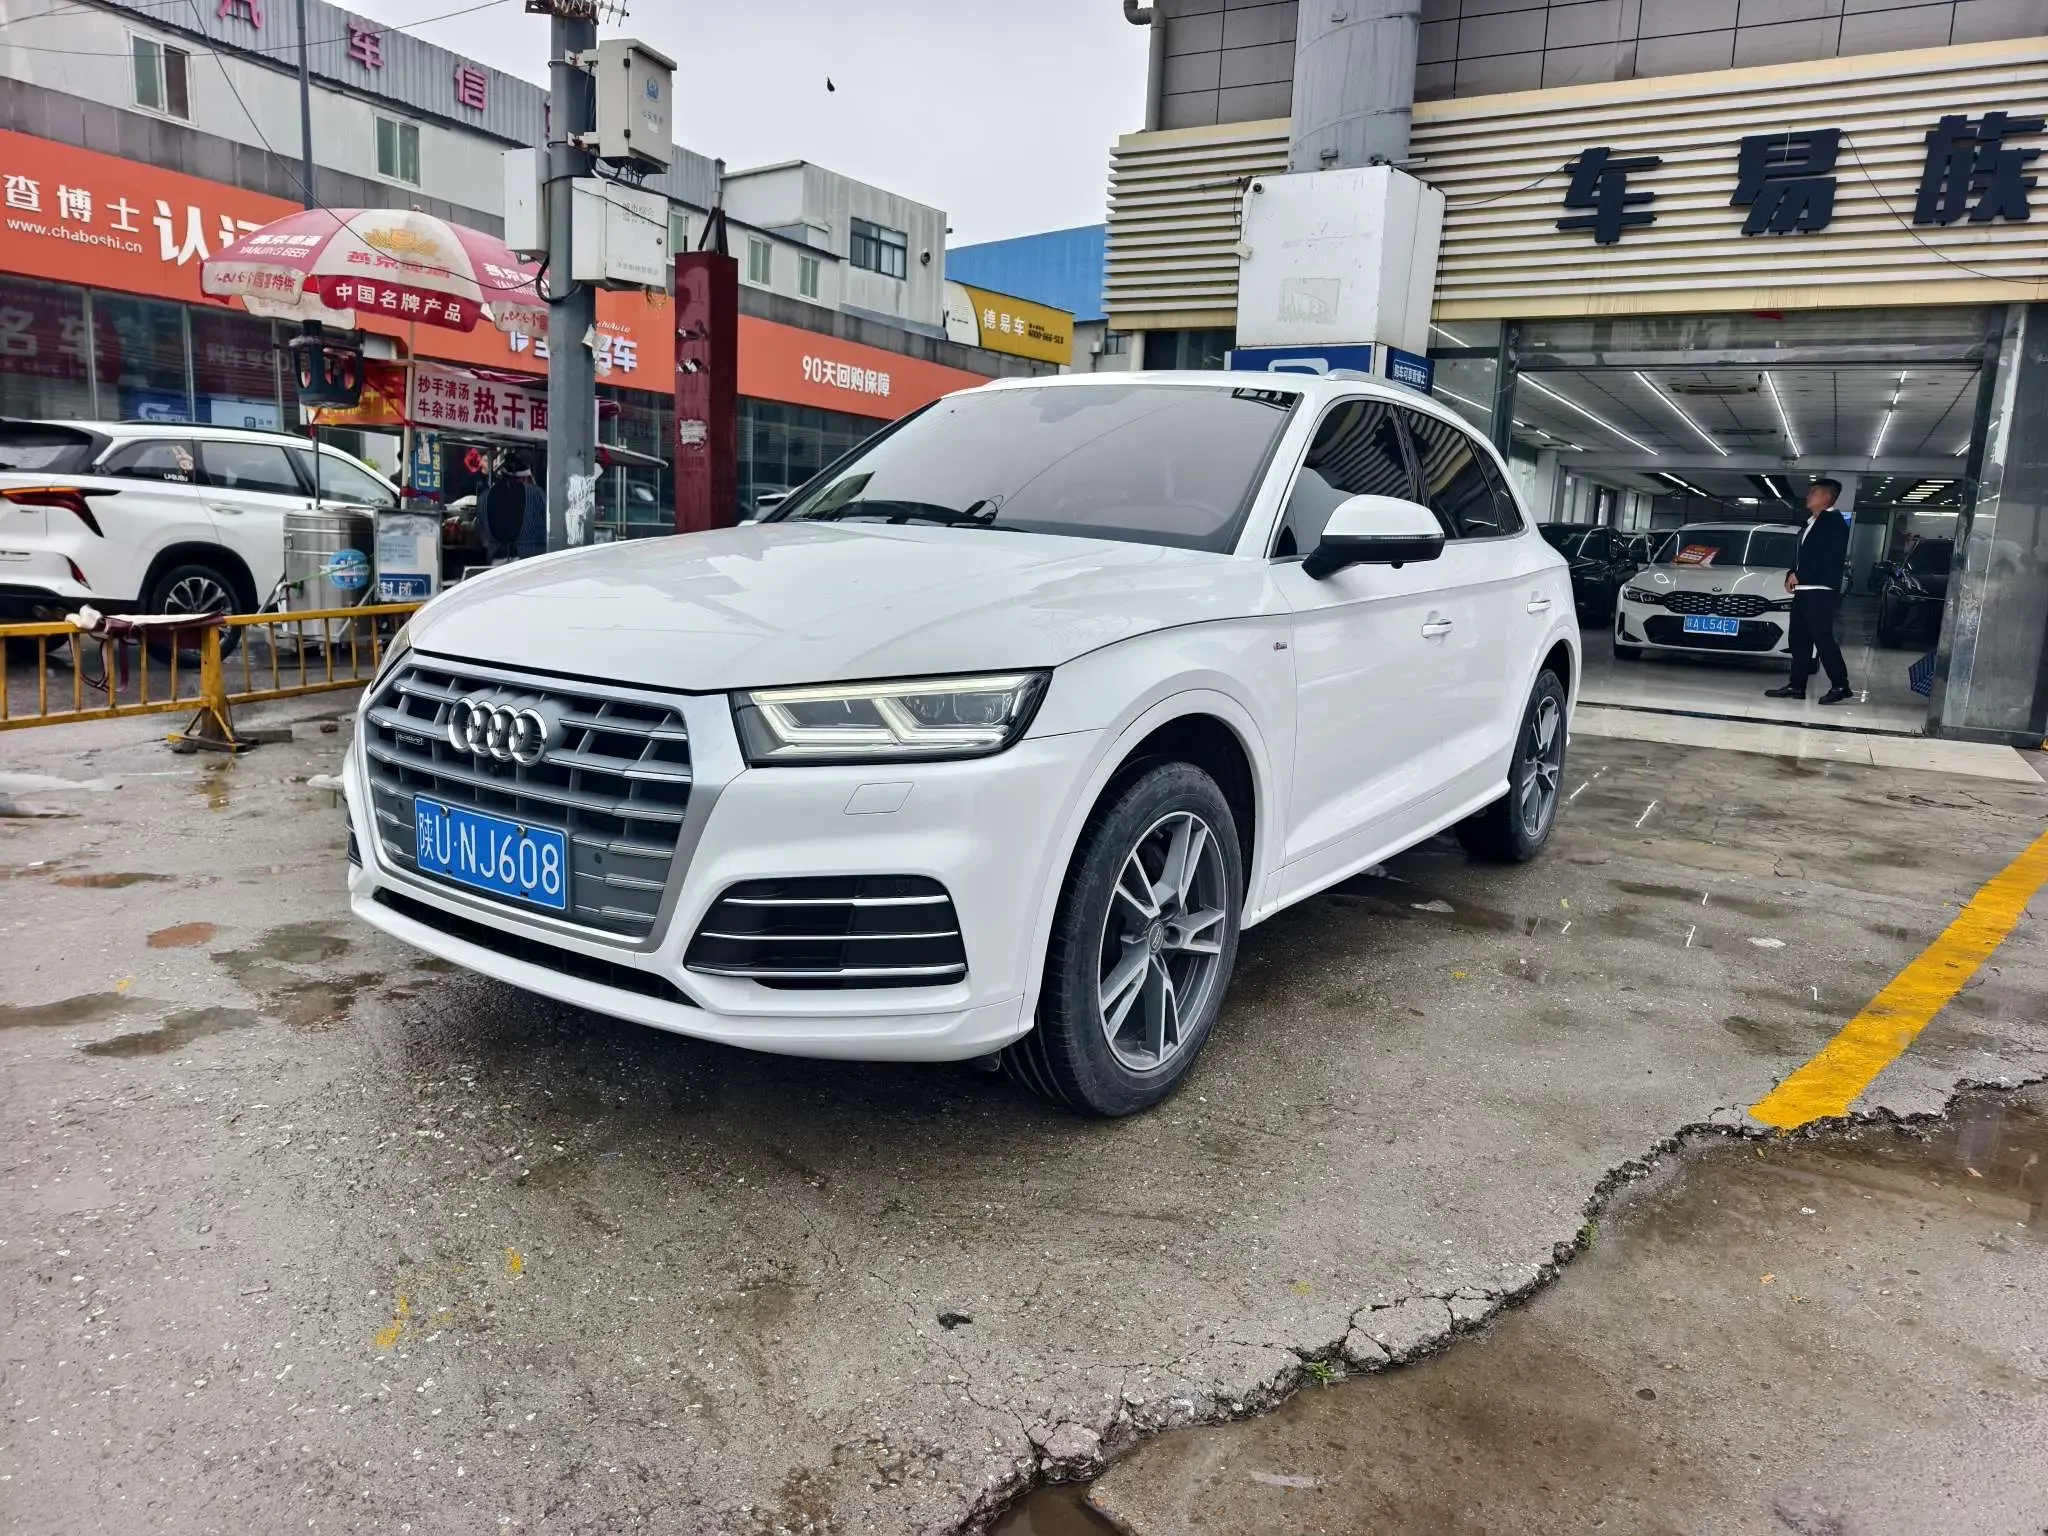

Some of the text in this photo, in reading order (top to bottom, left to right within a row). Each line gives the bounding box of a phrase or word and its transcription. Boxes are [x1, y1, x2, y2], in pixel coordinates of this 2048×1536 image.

[1557, 111, 2048, 245] 车易族
[3, 174, 140, 234] 查博士
[6, 218, 143, 254] www.chaboshi.cn
[335, 282, 461, 323] 中国名牌产品
[418, 375, 470, 401] 抄手清汤
[801, 354, 890, 398] 90天回购保障
[418, 398, 470, 424] 牛杂汤粉
[473, 386, 549, 433] 热干面
[418, 812, 561, 894] 陕U·NJ608
